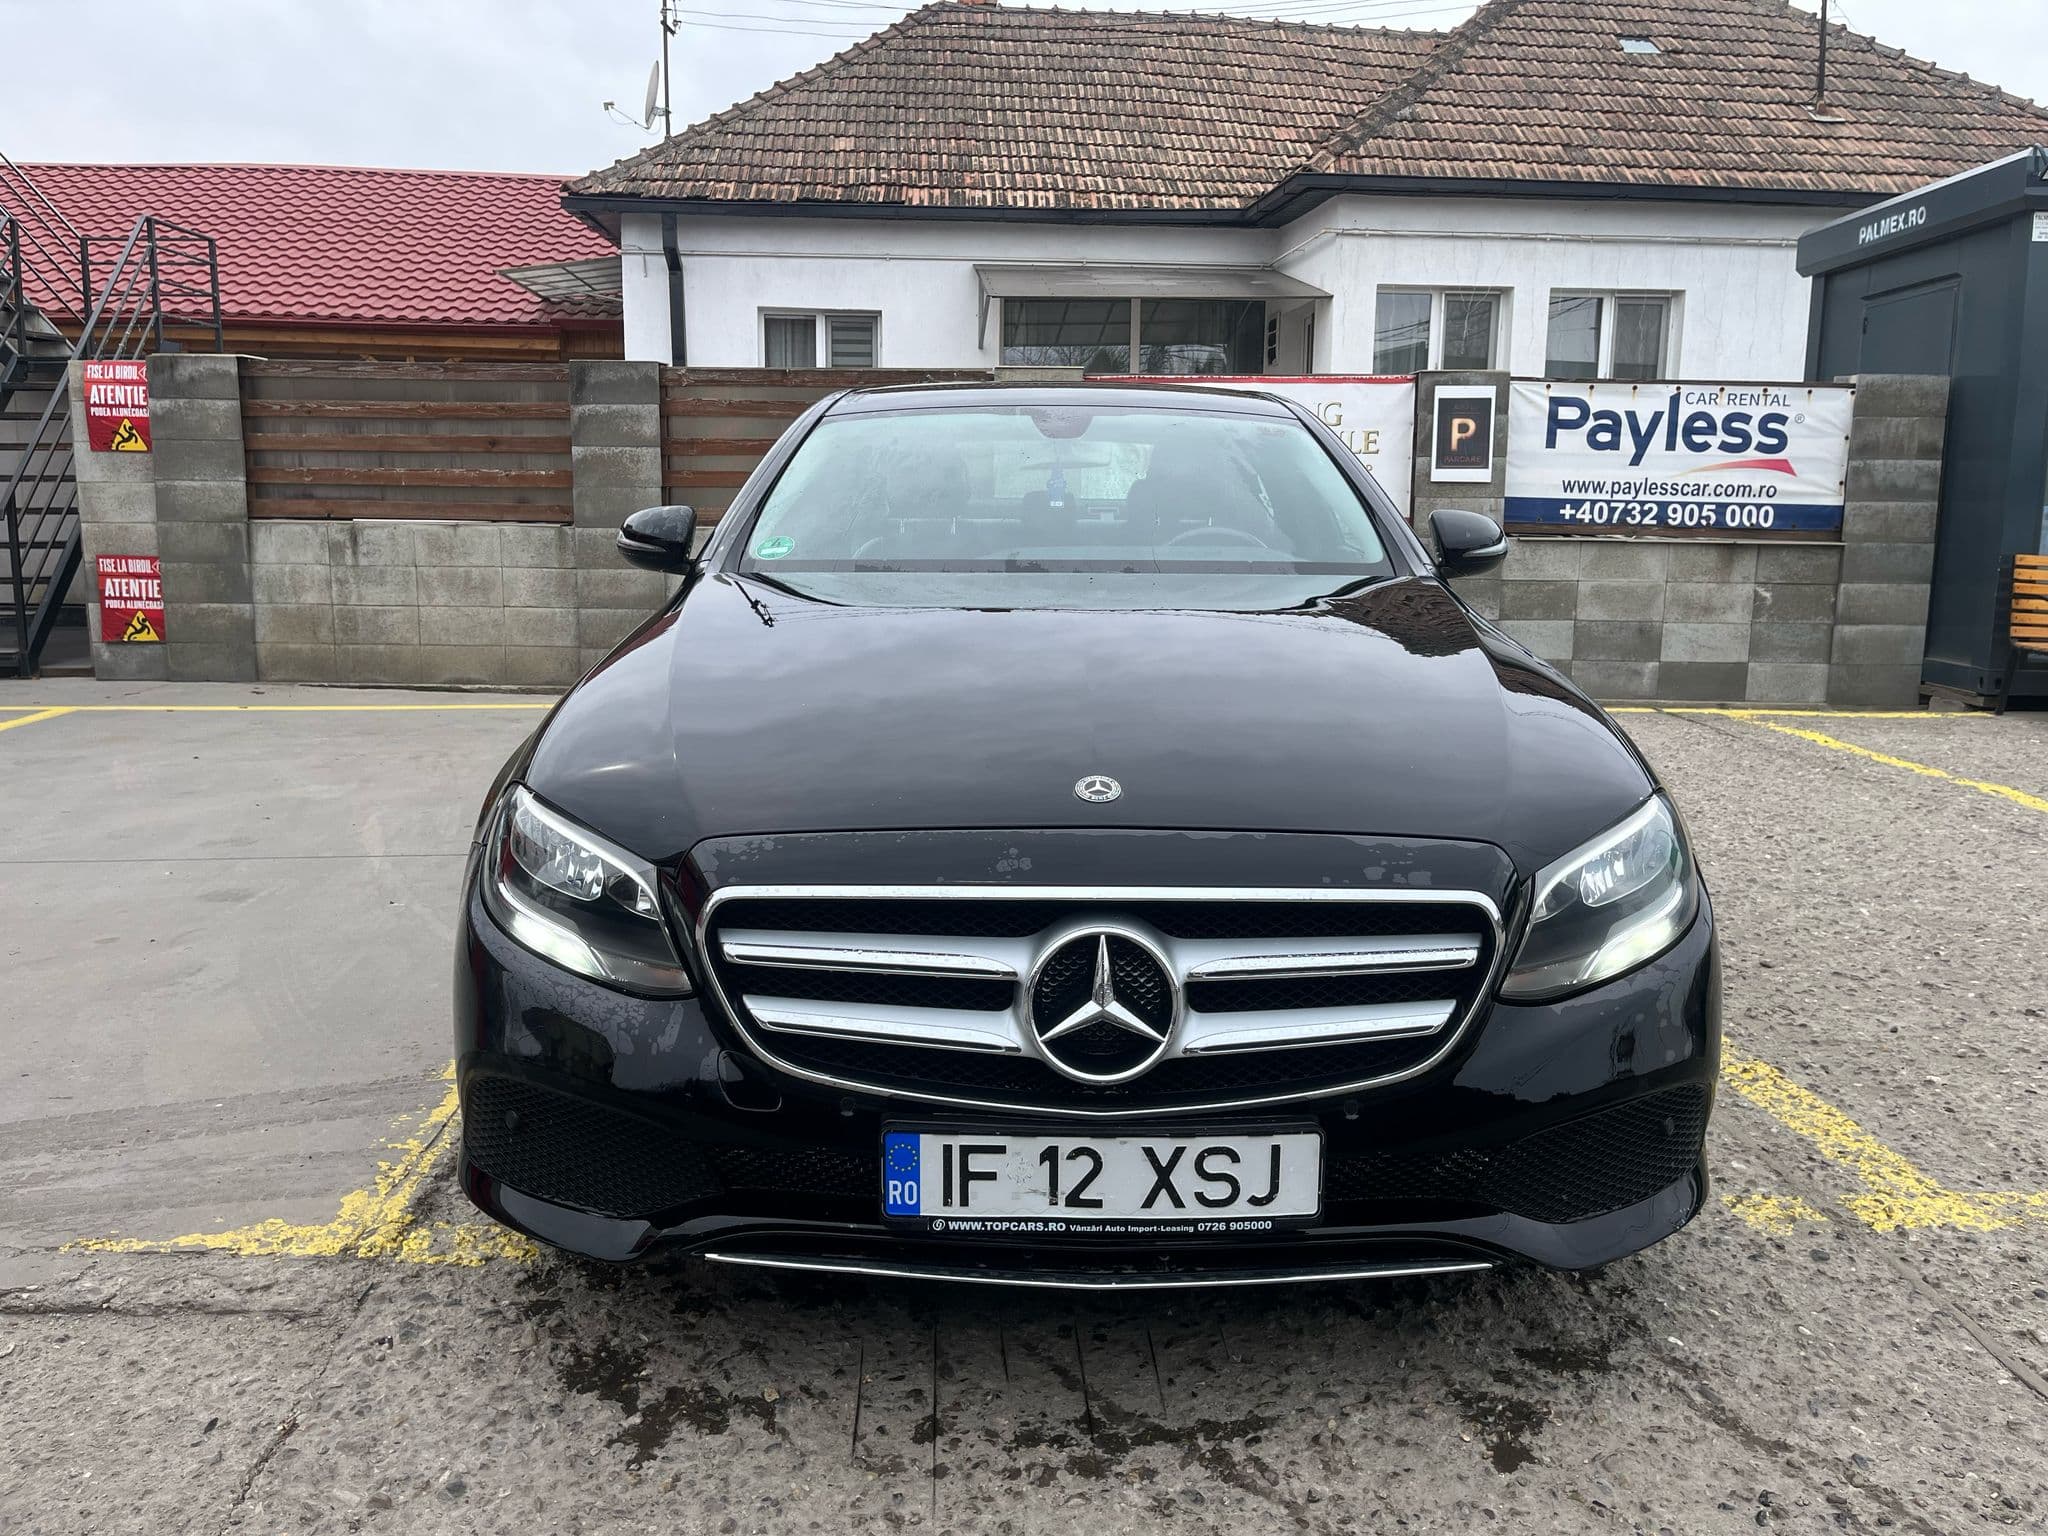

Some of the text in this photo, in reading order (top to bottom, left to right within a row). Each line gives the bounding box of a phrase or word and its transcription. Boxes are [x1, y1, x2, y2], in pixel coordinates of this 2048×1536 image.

[1858, 206, 1927, 245] PALMEX.RO
[104, 365, 114, 379] LA
[1685, 391, 1792, 408] CAR RENTAL
[90, 407, 112, 417] PODEA
[1451, 417, 1476, 452] P
[1545, 391, 1790, 466] Payless
[1561, 477, 1778, 500] www.paylesscar.com.ro
[1559, 501, 1775, 528] +40732 905 000
[116, 559, 127, 573] LA
[942, 1143, 1281, 1209] IF 12 XSJ
[889, 1180, 918, 1205] RO
[948, 1221, 1066, 1232] WWW.TOPCARS.RO
[1105, 1224, 1126, 1232] Auto
[1197, 1222, 1227, 1232] 0726
[1229, 1220, 1272, 1231] 905000
